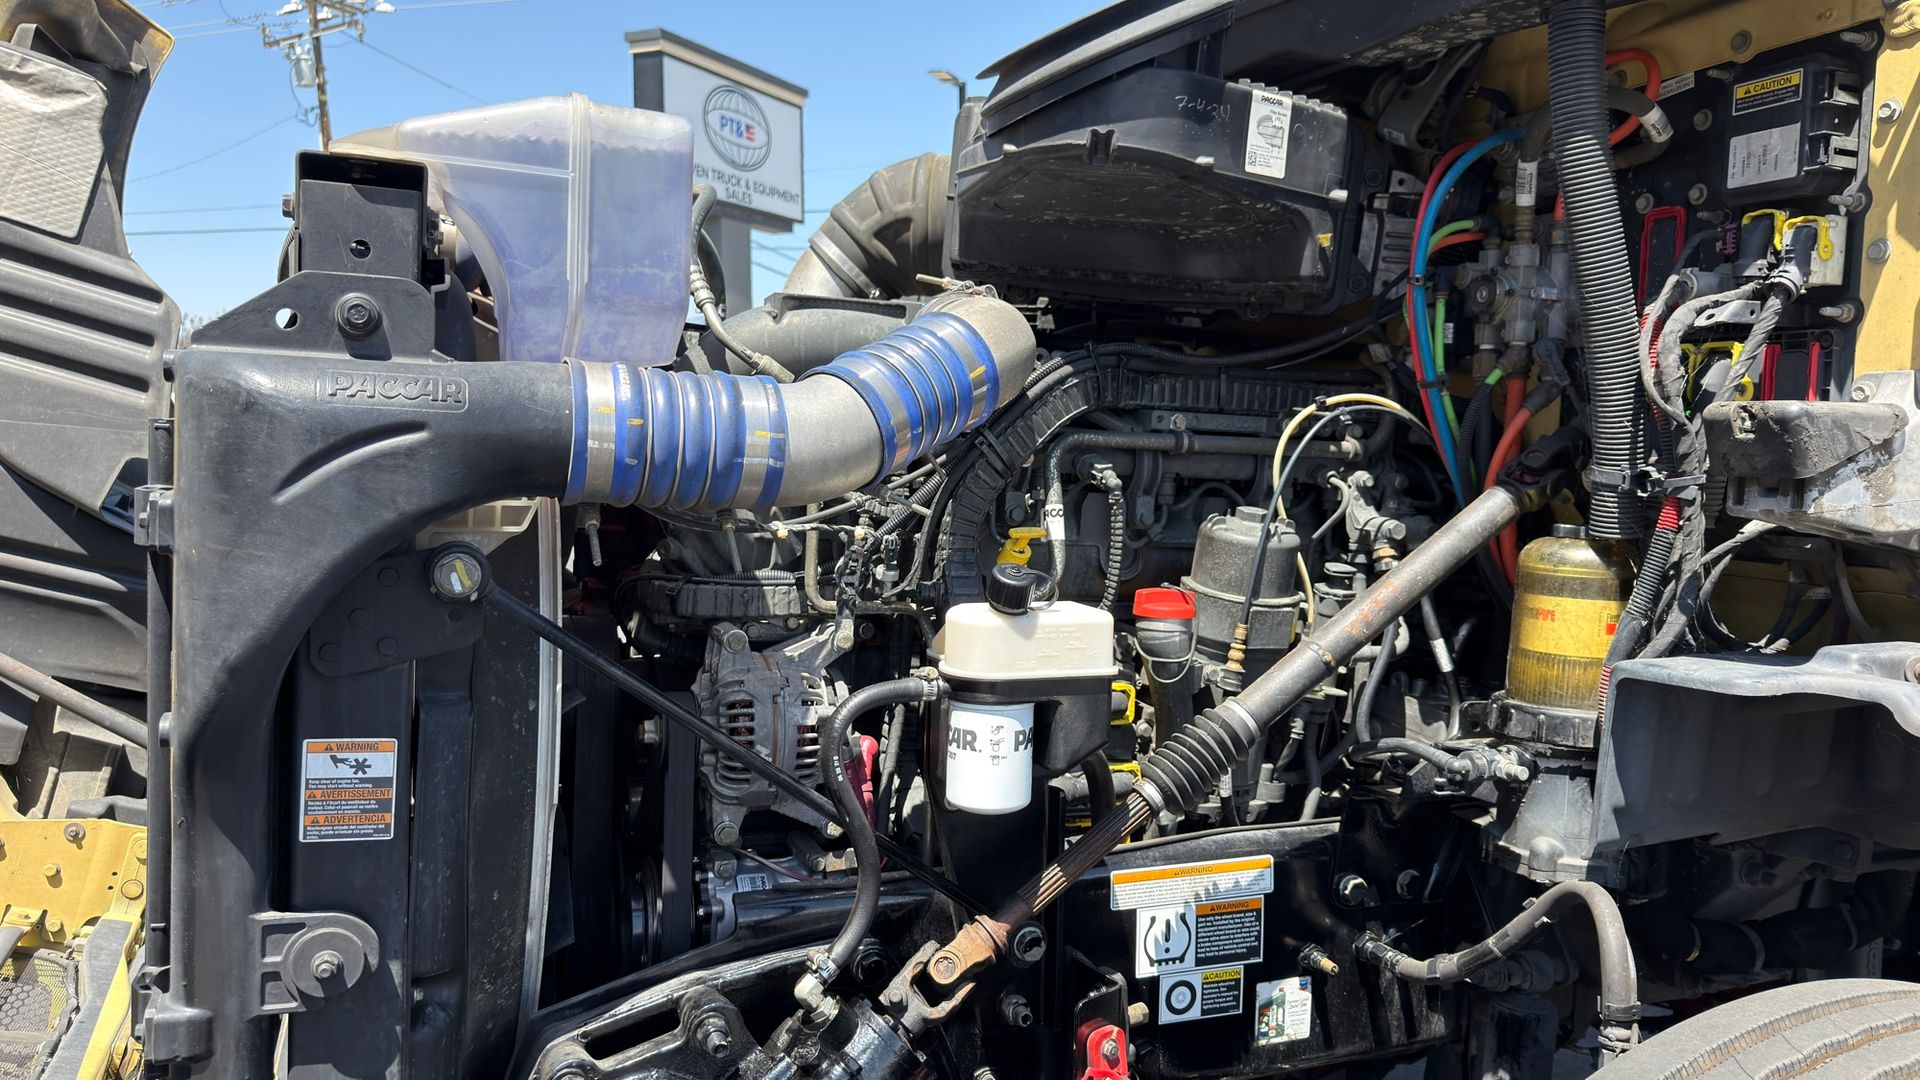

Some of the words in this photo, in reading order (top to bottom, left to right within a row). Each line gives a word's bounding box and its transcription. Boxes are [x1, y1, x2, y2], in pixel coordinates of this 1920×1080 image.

[1753, 75, 1793, 93] CAUTION
[1261, 95, 1284, 106] PACCAR
[719, 114, 756, 144] PT&E
[711, 169, 743, 188] TRUCK
[746, 179, 751, 190] &
[753, 182, 800, 204] EQUIPMENT
[725, 188, 754, 205] SALES
[328, 373, 462, 403] PACCAR
[336, 742, 379, 751] WARNING
[320, 789, 391, 798] AVERTISSEMENT
[323, 814, 386, 824] ADVERTENCIA
[1178, 865, 1213, 876] WARNING
[1215, 901, 1249, 912] WARNING
[1209, 970, 1241, 979] CAUTION
